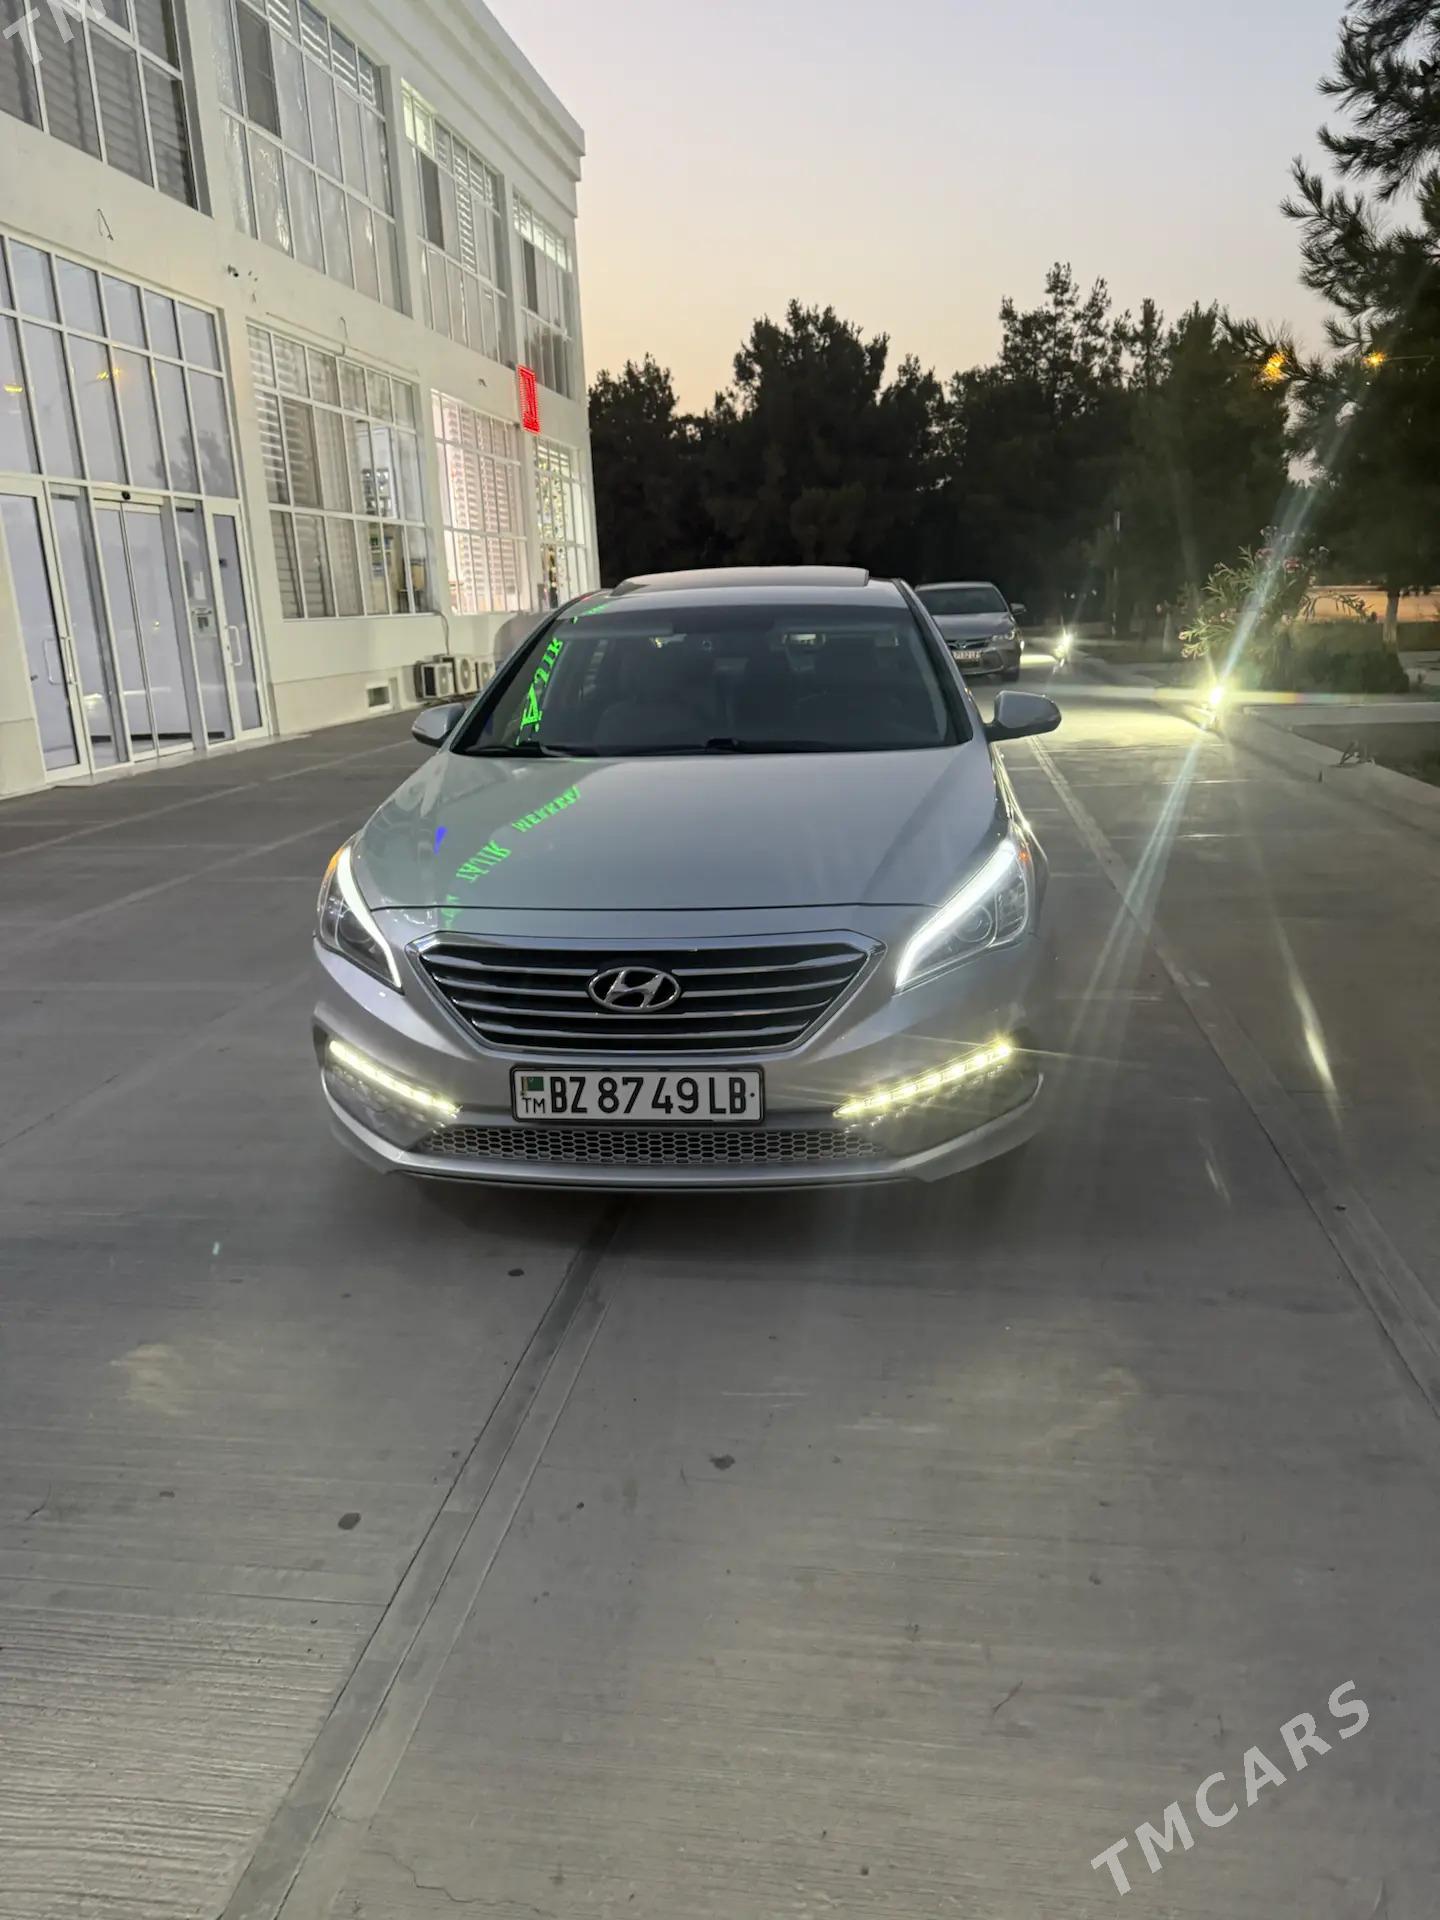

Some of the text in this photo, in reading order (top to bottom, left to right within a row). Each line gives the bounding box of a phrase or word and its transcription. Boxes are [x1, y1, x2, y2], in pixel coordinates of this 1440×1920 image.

[522, 1097, 546, 1114] TM
[550, 1076, 587, 1114] BZ
[709, 1076, 746, 1114] LB
